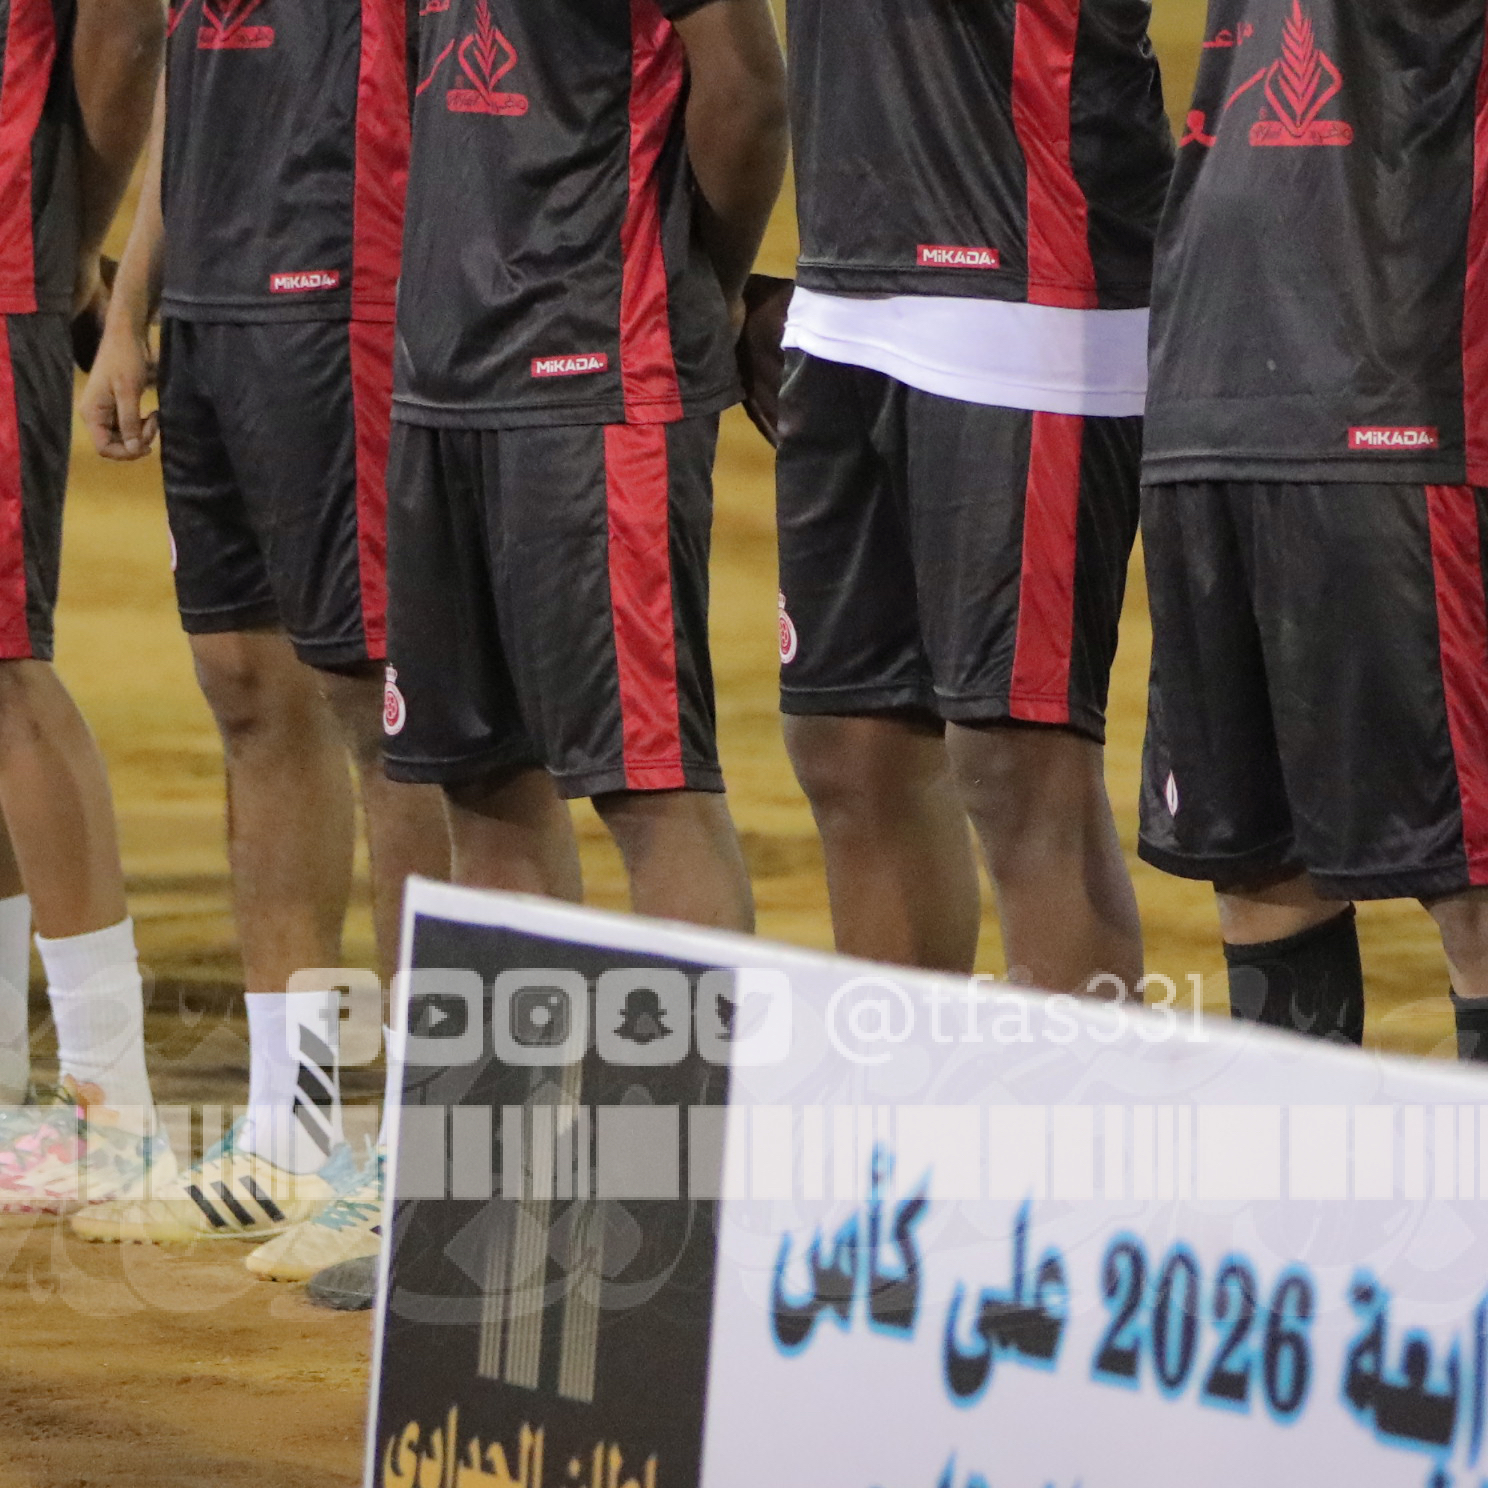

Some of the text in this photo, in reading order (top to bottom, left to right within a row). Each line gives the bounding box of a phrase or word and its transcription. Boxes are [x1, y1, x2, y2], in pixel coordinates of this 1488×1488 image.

[770, 1138, 935, 1358] كأس
[941, 1184, 1070, 1410] على
[1088, 1229, 1318, 1428] 2026
